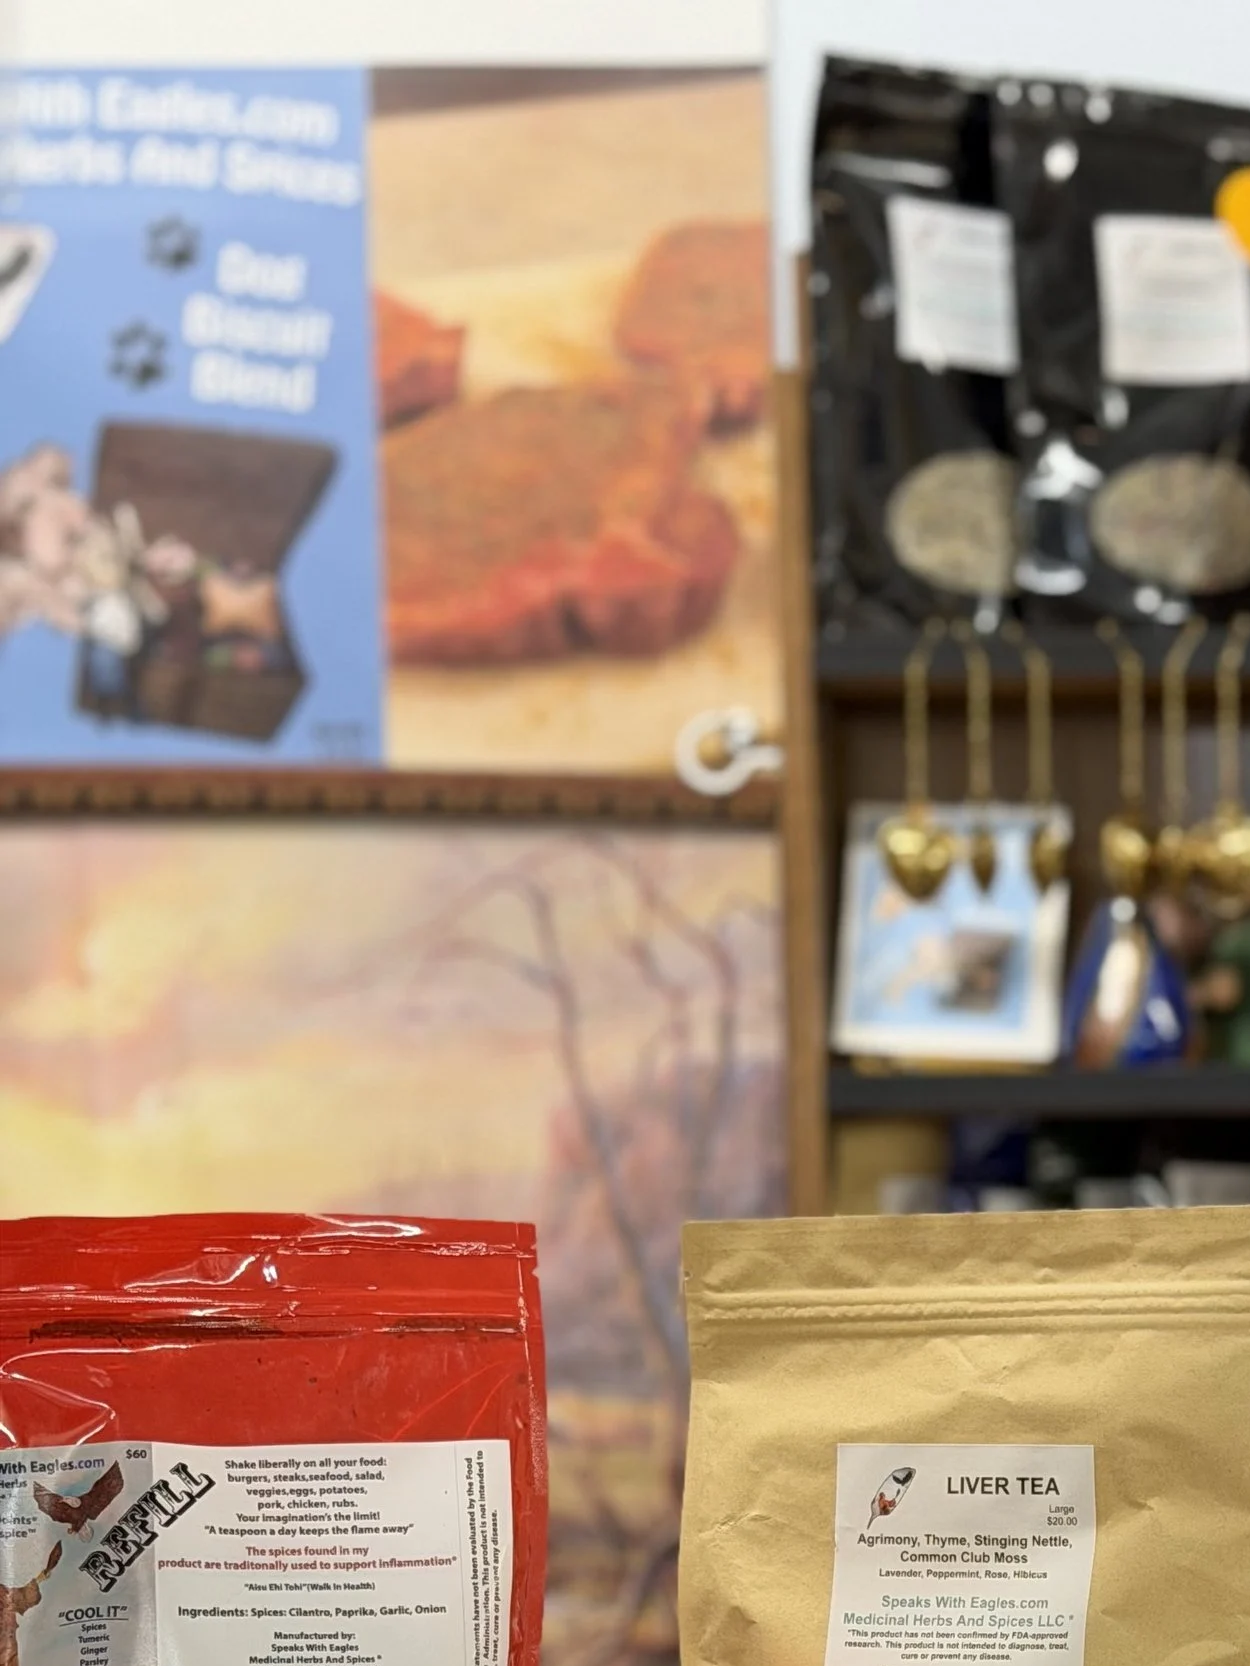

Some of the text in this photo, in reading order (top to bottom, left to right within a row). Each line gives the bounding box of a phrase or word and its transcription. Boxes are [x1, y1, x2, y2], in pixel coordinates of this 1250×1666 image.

[126, 1449, 147, 1459] $60
[31, 1458, 105, 1474] Eagles.com
[225, 1457, 387, 1469] Shake liberally on all your food:
[228, 1474, 270, 1483] burgers,
[355, 1471, 385, 1481] salad,
[320, 1486, 367, 1495] potatoes,
[947, 1477, 1060, 1495] LIVER TEA
[258, 1500, 358, 1510] pork, chicken, rubs.
[1048, 1505, 1075, 1514] Large
[79, 1462, 216, 1592] REFILL
[1047, 1516, 1077, 1526] $20.00
[219, 1527, 267, 1537] teaspoon
[278, 1527, 296, 1537] day
[300, 1526, 329, 1536] keeps
[332, 1526, 350, 1535] the
[352, 1525, 380, 1534] flame
[857, 1534, 1072, 1549] Agrimony, Thyme, Stinging Nettle,
[246, 1546, 369, 1558] The spices found in my
[900, 1551, 1028, 1564] Common Club Moss
[158, 1558, 202, 1570] product
[205, 1561, 221, 1570] are
[224, 1561, 288, 1572] traditonally
[291, 1561, 317, 1570] used
[320, 1561, 331, 1569] to
[333, 1560, 377, 1572] support
[881, 1595, 1048, 1611] Speaks With Eagles.com
[178, 1605, 446, 1618] Ingredients: Spices: Cilantro, Paprika, Garlic, Onion
[81, 1623, 106, 1633] Spices
[78, 1634, 110, 1643] Tumeric
[80, 1647, 108, 1656] Ginger
[80, 1658, 108, 1666] Parsley
